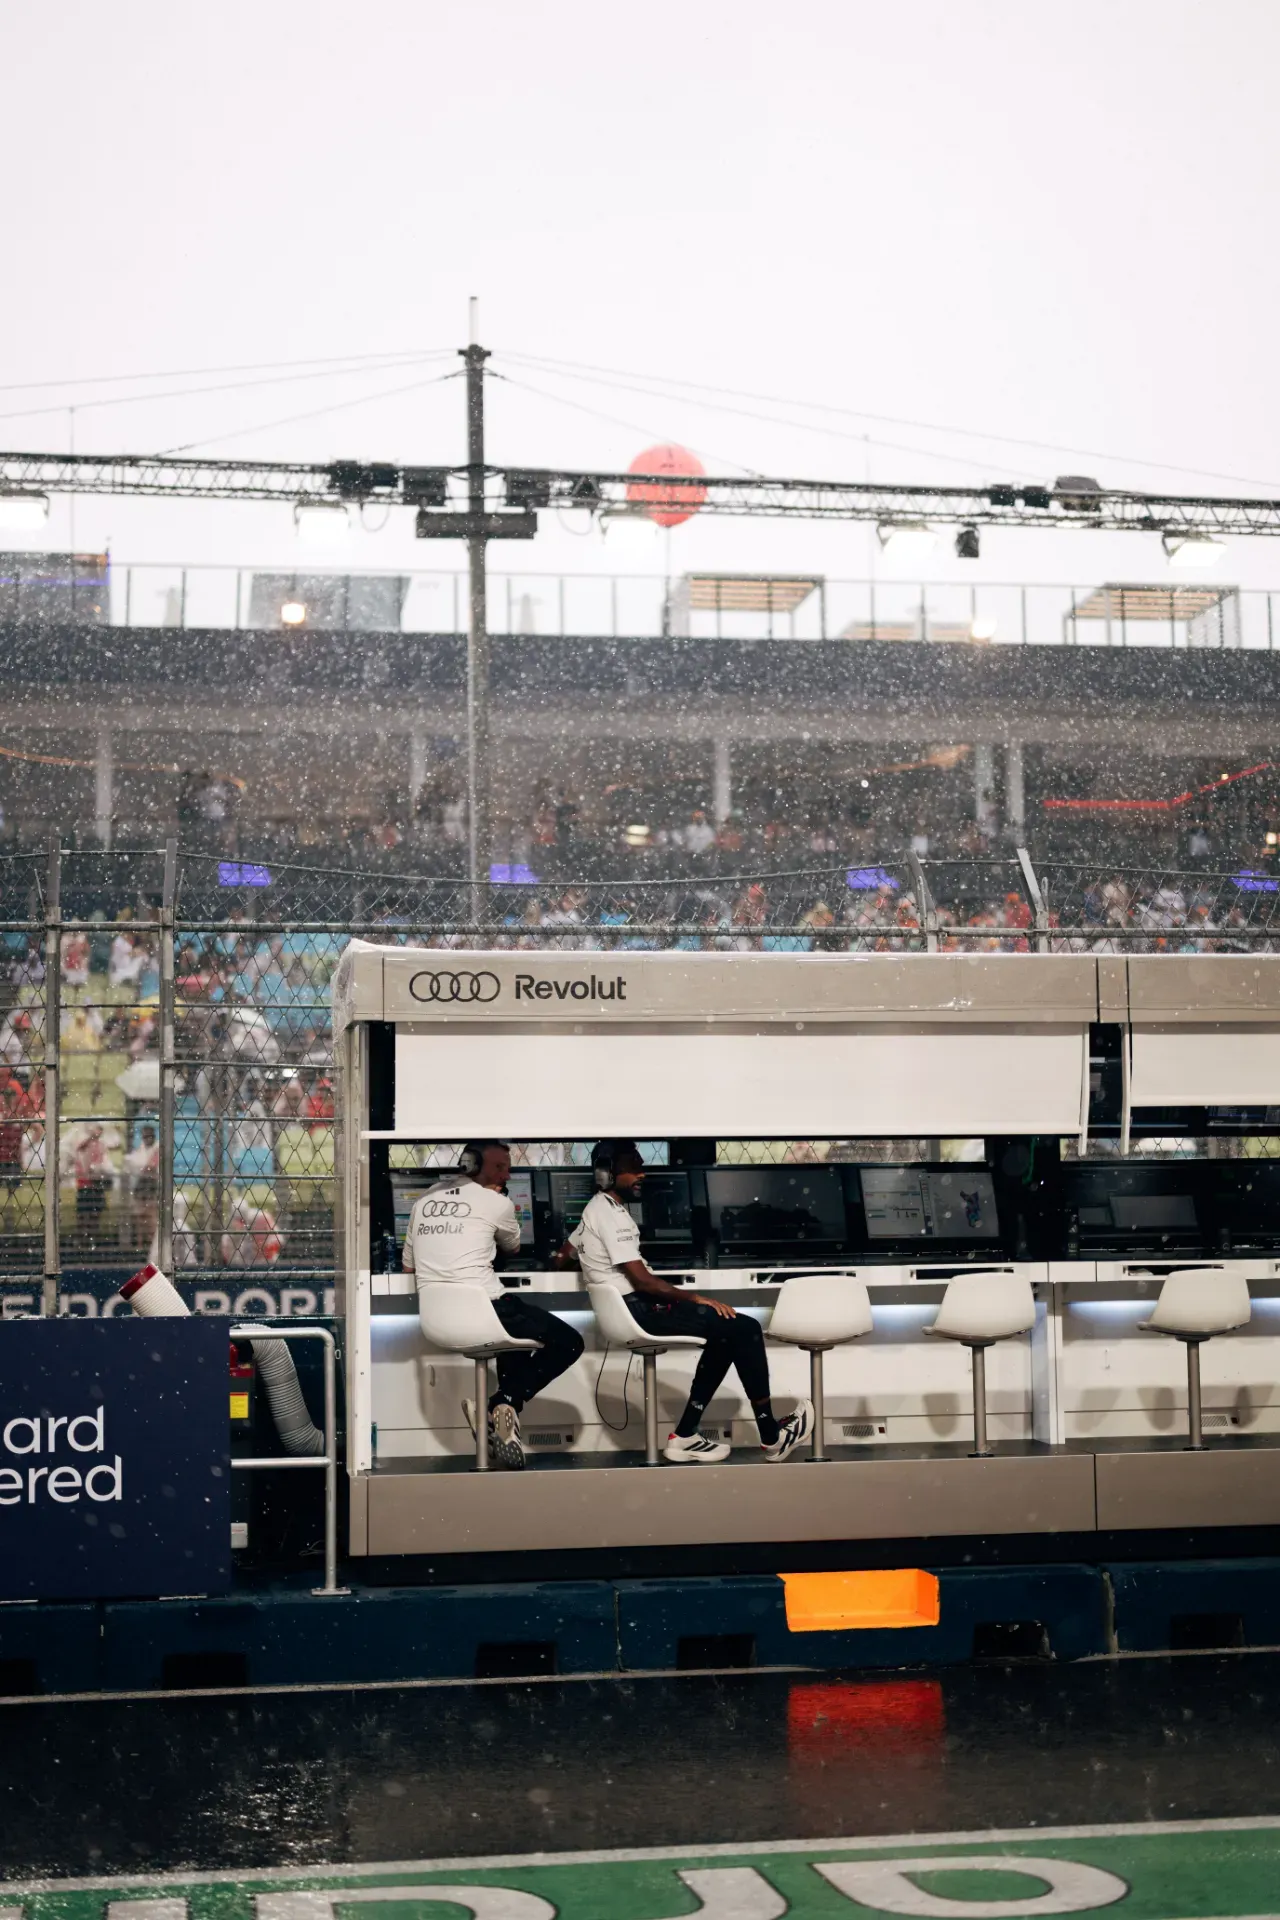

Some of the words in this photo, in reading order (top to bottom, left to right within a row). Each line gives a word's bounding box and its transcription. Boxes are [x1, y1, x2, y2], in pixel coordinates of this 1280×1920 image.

[515, 974, 627, 1000] Revolut
[417, 1221, 465, 1236] Revolut
[3, 1404, 104, 1455] ard
[0, 1454, 122, 1505] ered
